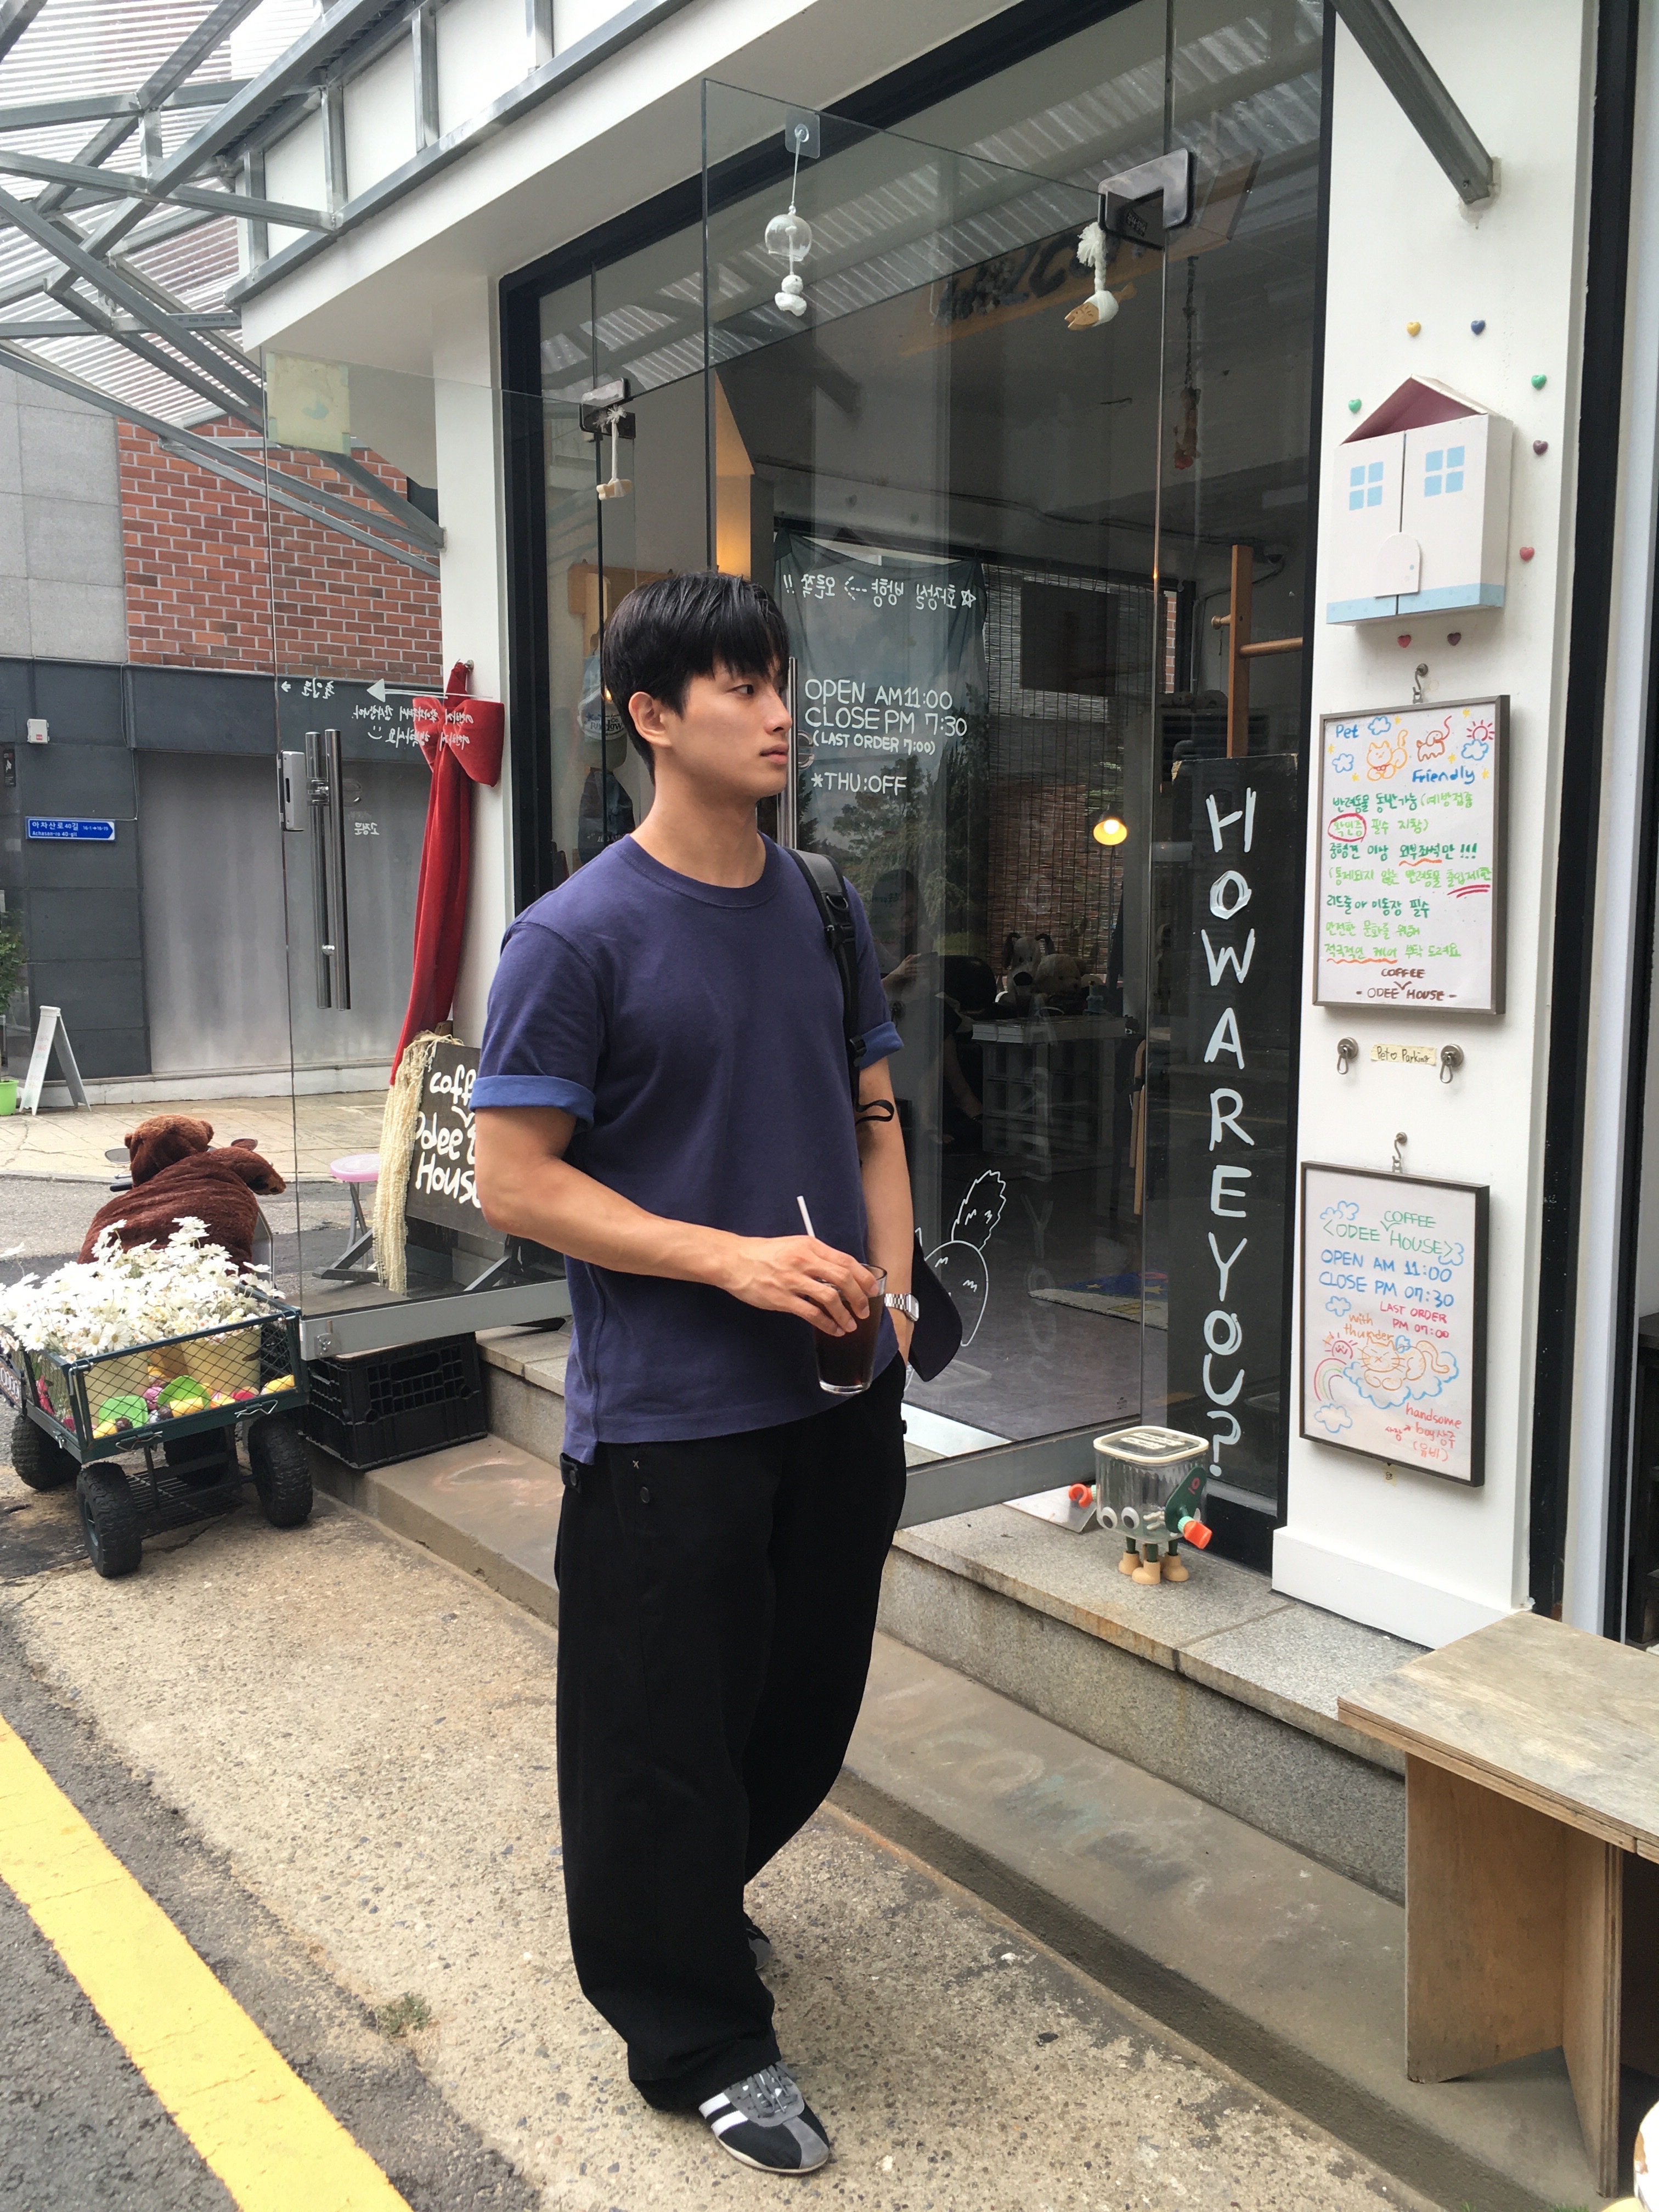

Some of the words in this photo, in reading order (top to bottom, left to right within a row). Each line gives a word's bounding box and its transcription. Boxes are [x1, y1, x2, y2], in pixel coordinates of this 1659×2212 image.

[804, 679, 865, 704] OPEN
[804, 706, 881, 730] CLOSE
[884, 710, 915, 735] PM
[925, 713, 967, 737] 7:30
[1336, 725, 1359, 738] Pet
[812, 730, 850, 747] (LAST
[855, 734, 899, 753] ORDER
[903, 739, 936, 756] 7:00)
[1412, 766, 1475, 785] Friendly
[1333, 794, 1369, 814] 반려동물
[1371, 819, 1389, 834] 필수
[1367, 845, 1389, 861] 이상
[1405, 869, 1442, 888] 반려동물
[1327, 895, 1352, 915] 리드줄
[1372, 898, 1402, 916] 이동장
[1409, 899, 1430, 918] 필수
[1326, 922, 1356, 936] 안전한
[1363, 920, 1390, 940] 문화를
[1381, 967, 1425, 978] COFFEE
[1367, 988, 1400, 998] ODEE
[1406, 989, 1444, 1001] HOUSE
[1377, 1046, 1390, 1061] Pet
[1402, 1049, 1430, 1063] Parking
[430, 1064, 477, 1106] coff
[1384, 1210, 1436, 1228] COFFEE
[1321, 1249, 1364, 1268] OPEN
[1373, 1257, 1395, 1272] AM
[1404, 1260, 1453, 1283] 11:00
[1319, 1271, 1368, 1293] CLOSE
[1375, 1280, 1397, 1296] PM
[1404, 1286, 1454, 1308] 07:30
[1348, 1313, 1374, 1325] with
[1380, 1301, 1406, 1315] LAST
[1410, 1308, 1448, 1324] ORDER
[1344, 1323, 1394, 1340] thunder
[1392, 1318, 1409, 1331] PM
[1414, 1324, 1449, 1339] 07:00
[1406, 1402, 1462, 1429] handsome
[1415, 1421, 1435, 1442] boy
